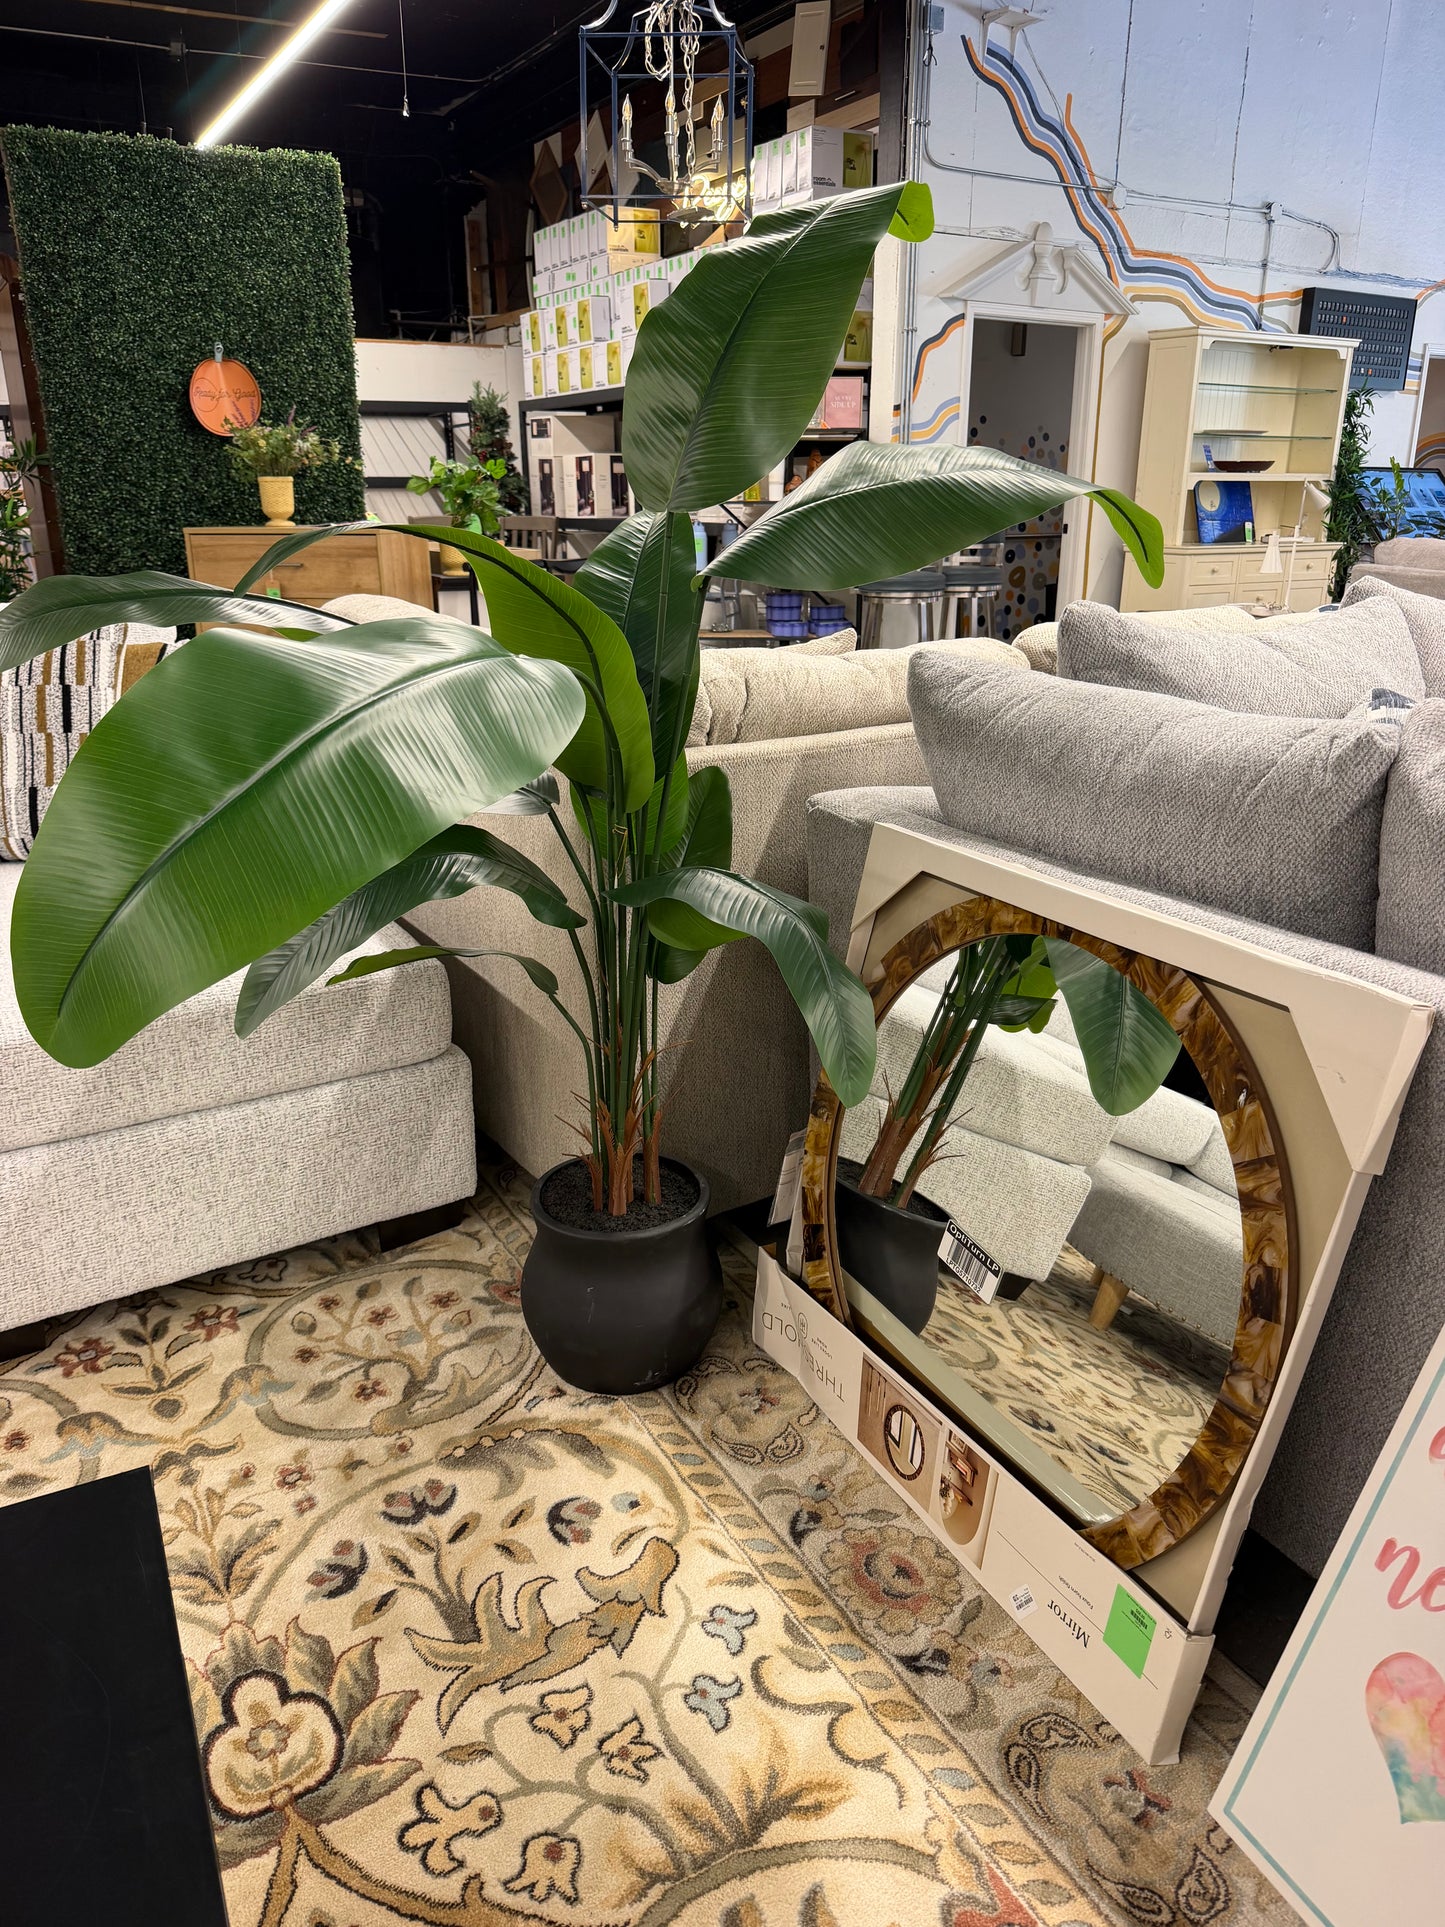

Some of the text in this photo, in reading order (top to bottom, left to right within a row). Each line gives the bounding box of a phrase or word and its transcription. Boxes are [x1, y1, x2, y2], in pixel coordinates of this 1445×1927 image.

[949, 1223, 1000, 1272] OptiTurn LP
[1047, 1599, 1091, 1649] Mirror
[1081, 1596, 1095, 1610] Faux
